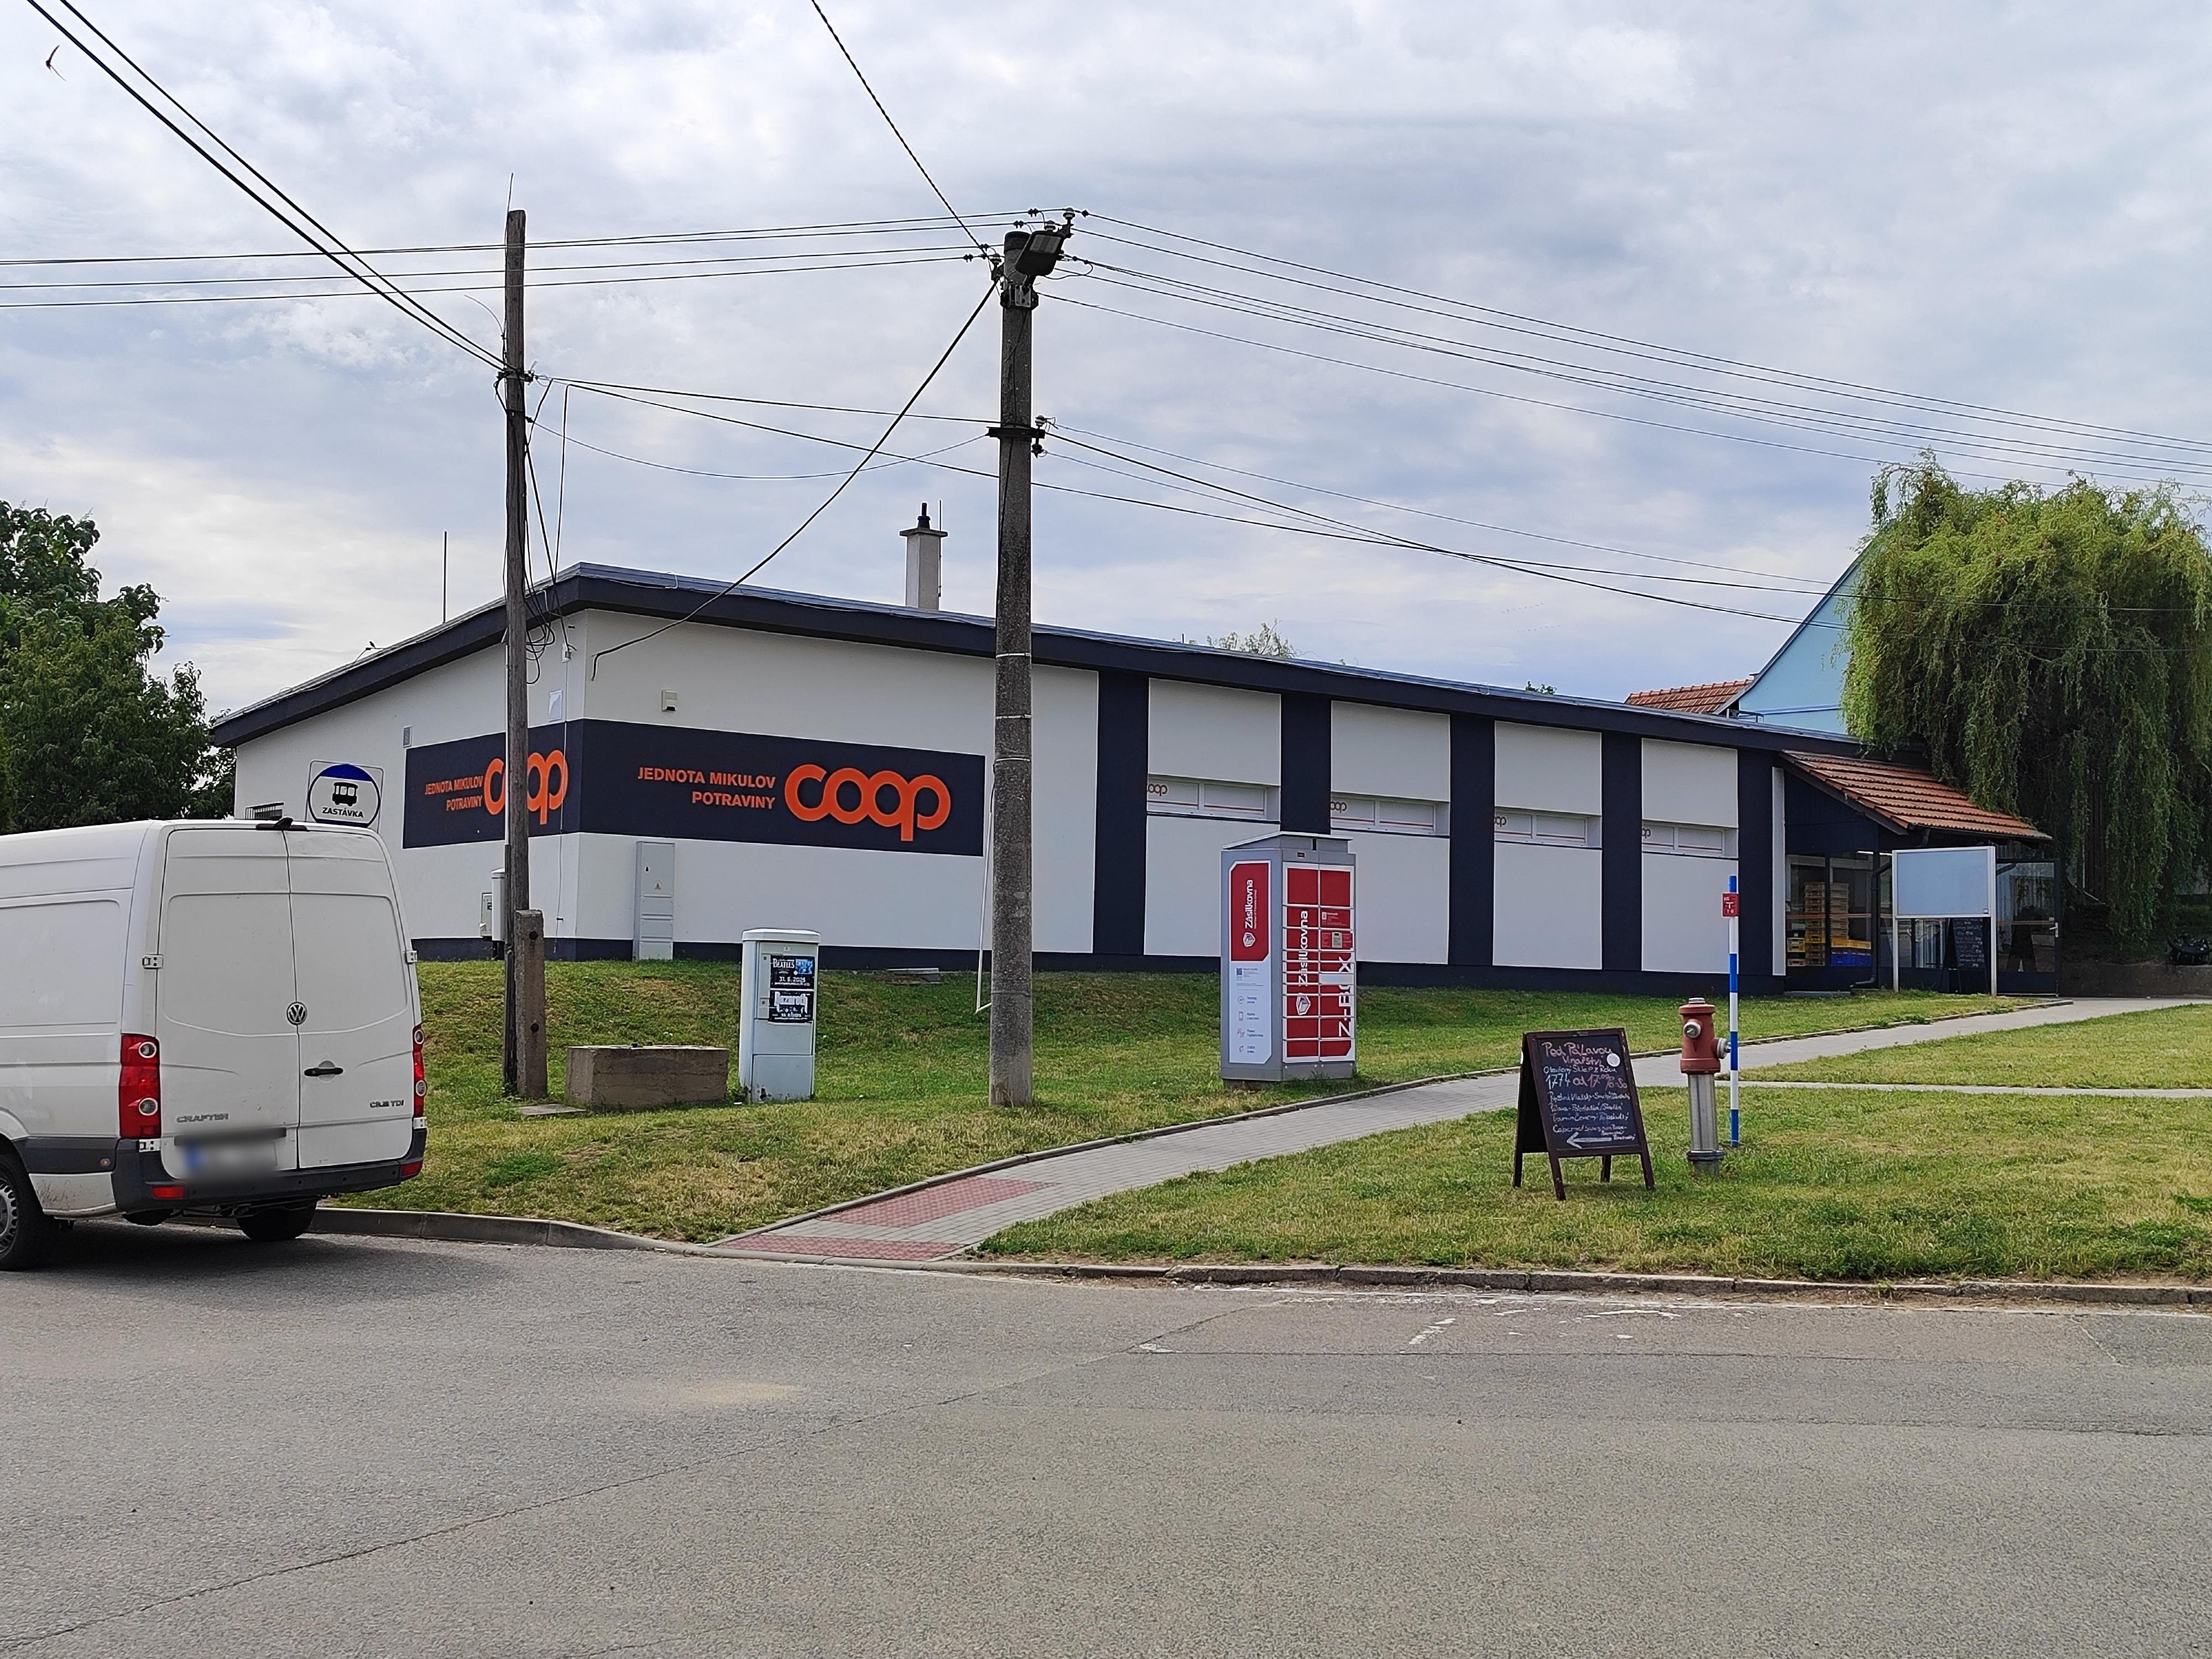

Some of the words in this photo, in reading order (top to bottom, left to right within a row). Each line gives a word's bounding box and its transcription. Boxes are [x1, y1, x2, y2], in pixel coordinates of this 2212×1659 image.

[425, 781, 452, 795] JEDNOTA
[454, 775, 483, 790] MIKULOV
[638, 767, 706, 784] JEDNOTA
[709, 772, 776, 789] MIKULOV
[446, 795, 482, 811] POTRAVINY
[692, 791, 775, 809] POTRAVINY
[322, 807, 363, 818] ZASTÁVKA
[1245, 879, 1253, 928] Zásilkovna
[1298, 911, 1308, 987] Zásilkovna
[1546, 1073, 1571, 1089] 1774
[1573, 1076, 1588, 1086] od
[176, 1113, 228, 1123] CRAFTER
